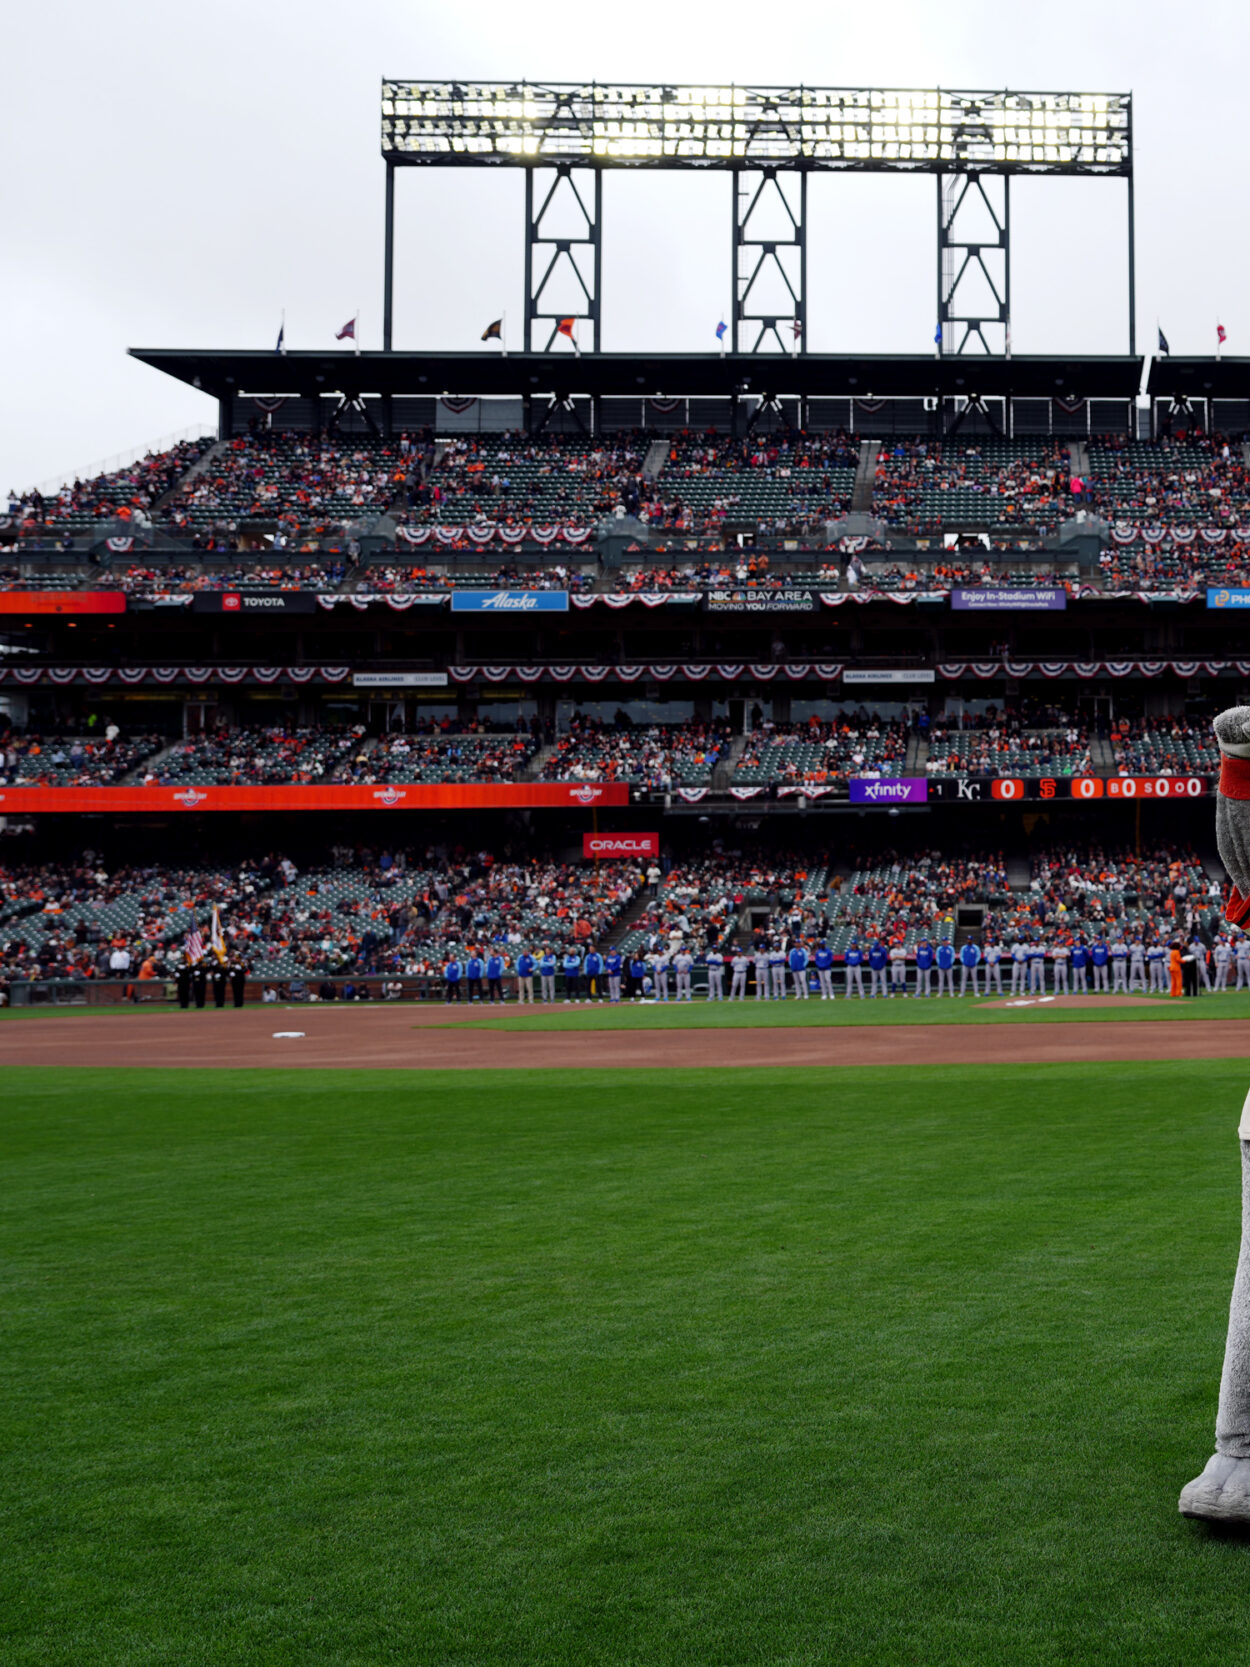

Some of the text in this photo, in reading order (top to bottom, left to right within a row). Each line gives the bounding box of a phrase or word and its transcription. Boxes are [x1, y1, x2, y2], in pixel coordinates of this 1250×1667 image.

[243, 597, 285, 607] TOYOTA
[481, 591, 537, 610] Alaska
[708, 591, 813, 600] NBC BAY AREA
[961, 591, 1056, 602] Enjoy In-Stadium WiFi
[864, 782, 912, 799] xfinity
[936, 785, 943, 796] 1
[957, 779, 1015, 800] KC 0
[1039, 778, 1095, 799] SF 0
[1110, 783, 1119, 793] B
[1121, 778, 1136, 797] 0
[1144, 782, 1152, 793] S
[1155, 778, 1170, 797] 0
[1187, 778, 1201, 797] 0
[589, 840, 652, 851] ORACLE
